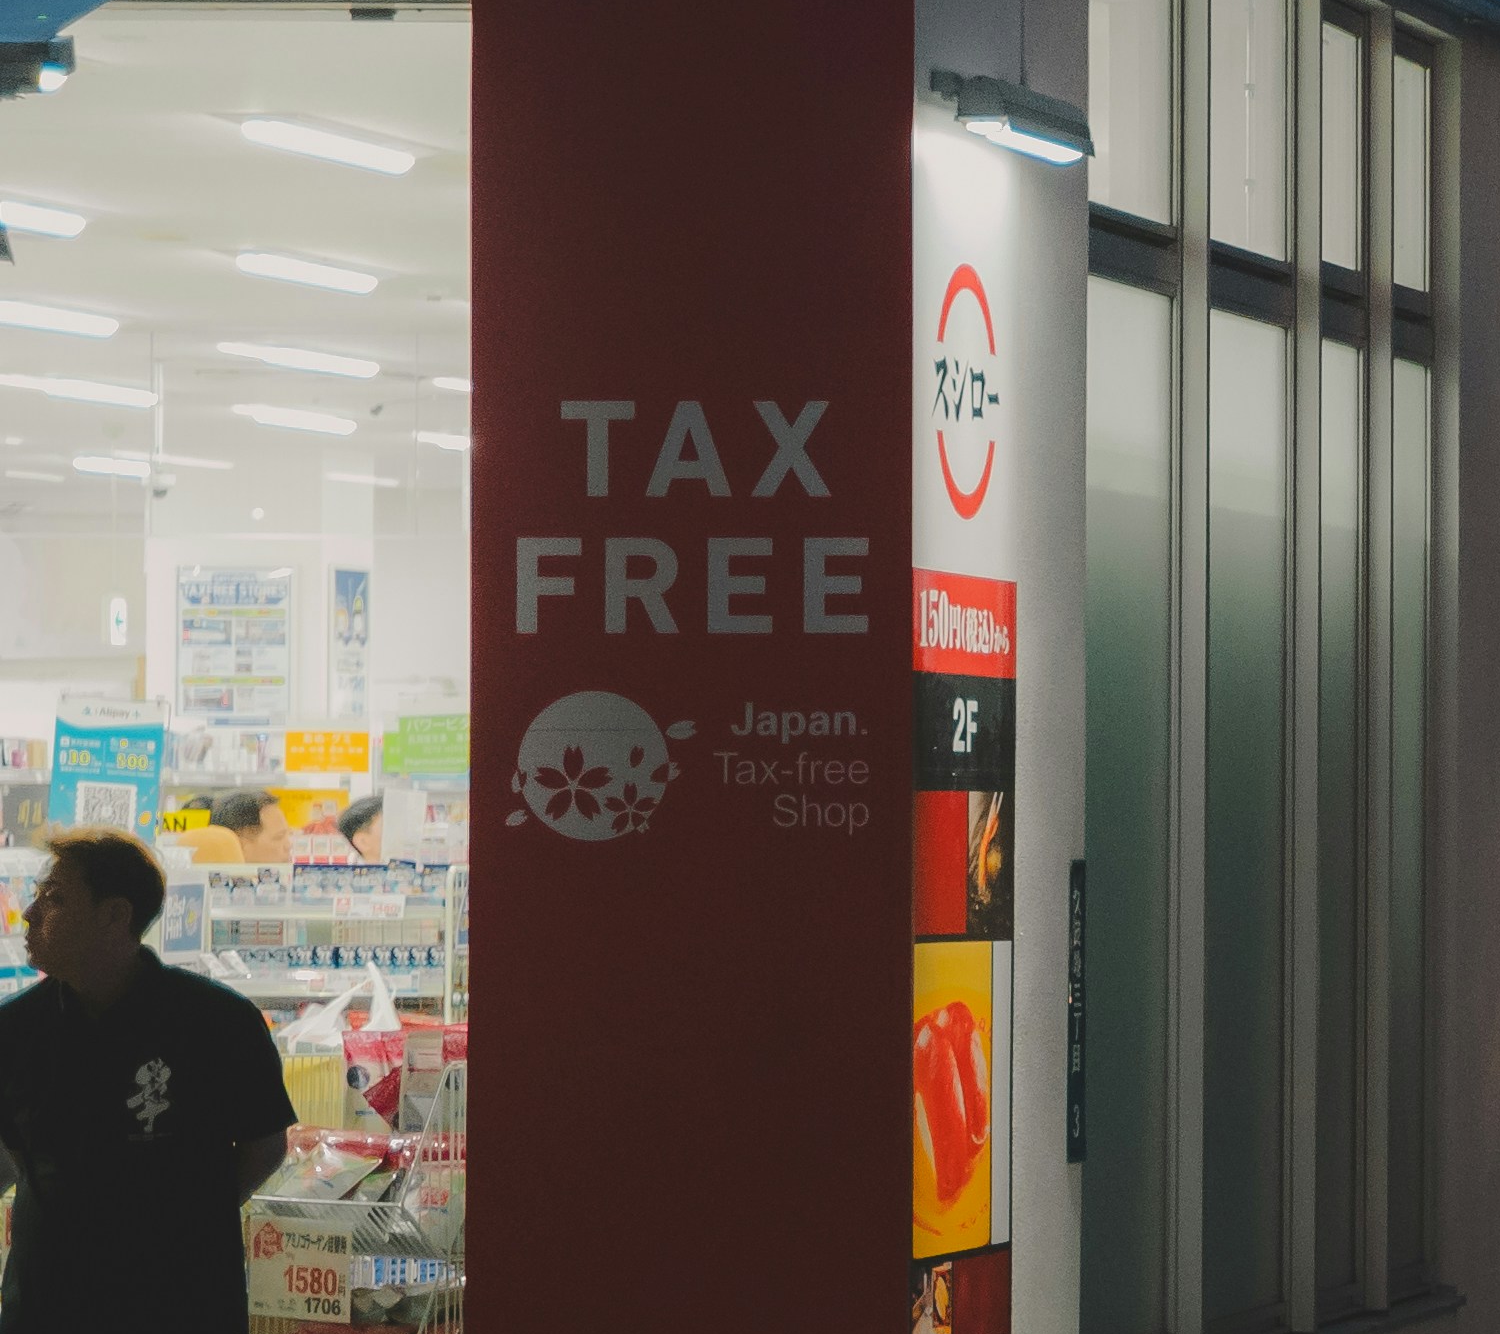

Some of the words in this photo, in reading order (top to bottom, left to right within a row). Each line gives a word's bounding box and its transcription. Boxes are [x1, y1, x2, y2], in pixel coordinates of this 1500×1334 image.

[931, 357, 1001, 422] スシロー
[559, 399, 832, 498] TAX
[514, 536, 870, 634] FREE
[729, 702, 869, 746] Japan.
[952, 697, 979, 753] 2F
[713, 750, 870, 787] Tax-free
[771, 794, 870, 836] Shop
[284, 1265, 337, 1297] 1580
[304, 1297, 341, 1316] 1706
